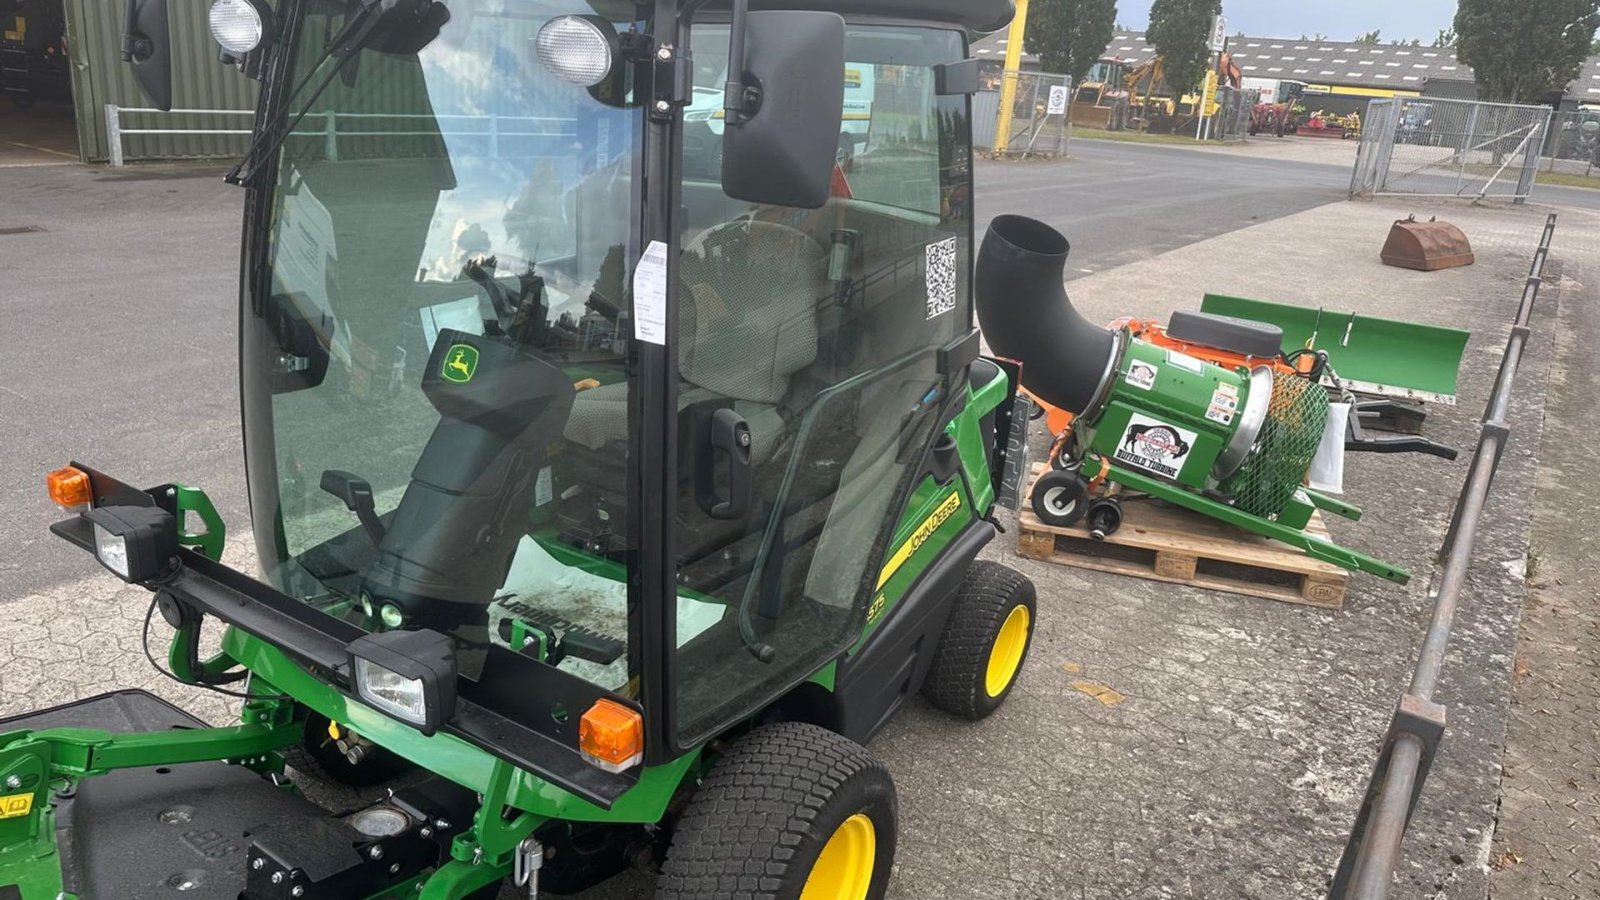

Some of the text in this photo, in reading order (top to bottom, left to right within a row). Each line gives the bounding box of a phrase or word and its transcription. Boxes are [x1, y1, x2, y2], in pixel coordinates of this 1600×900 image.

[1117, 449, 1145, 465] BUFFALO
[1148, 460, 1178, 477] TURBINE
[908, 496, 958, 556] JOHN DEERE
